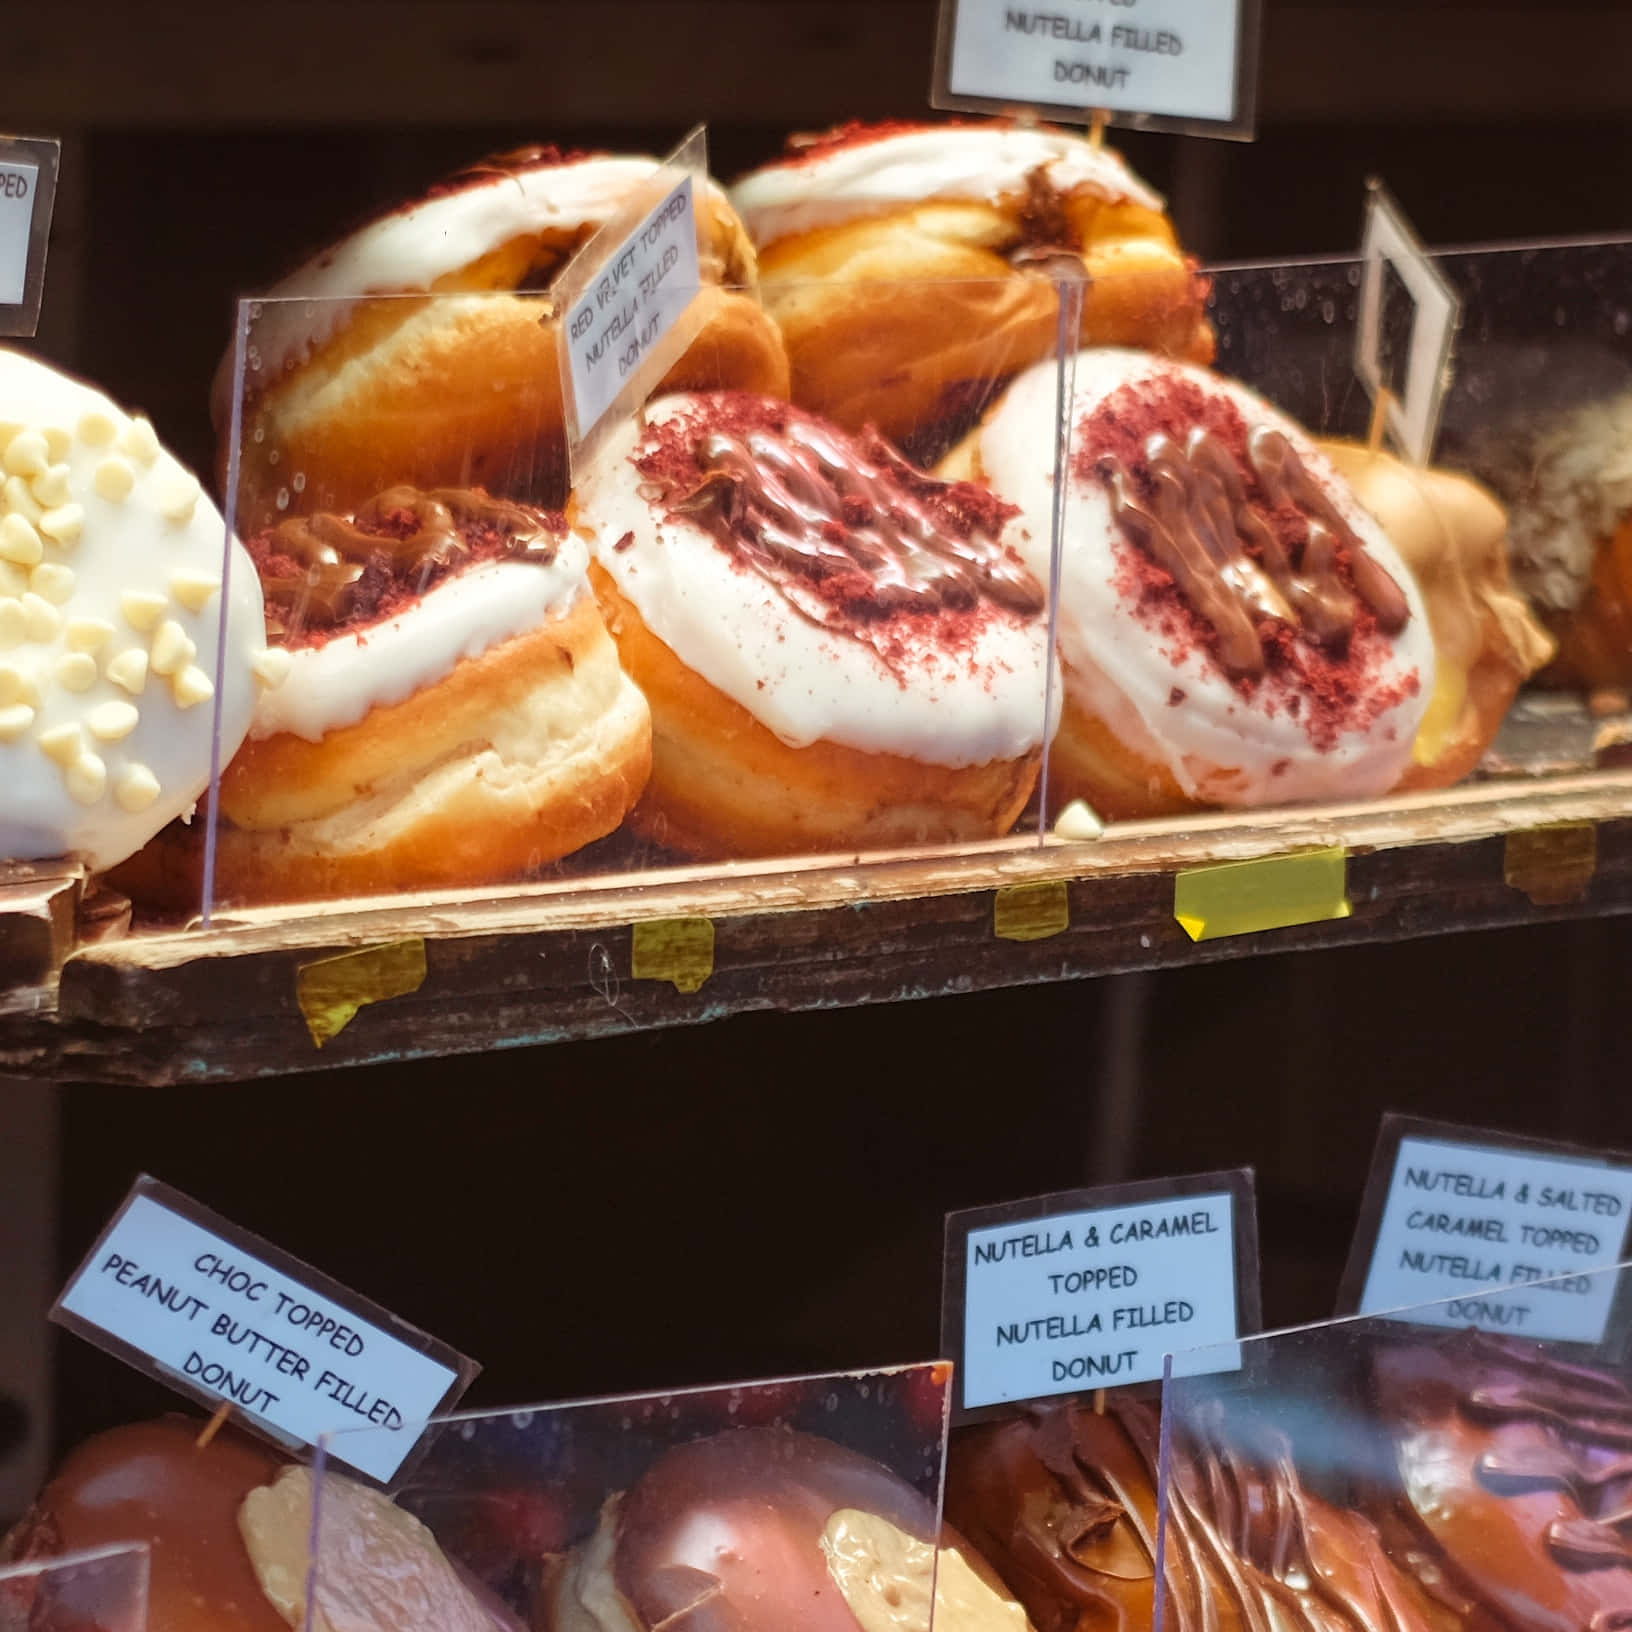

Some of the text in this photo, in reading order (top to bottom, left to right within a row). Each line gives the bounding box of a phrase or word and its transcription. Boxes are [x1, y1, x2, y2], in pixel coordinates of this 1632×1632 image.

[1005, 11, 1182, 56] NUTELLA FILLED
[1053, 60, 1130, 90] DONUT
[570, 308, 594, 344] RED
[641, 194, 687, 251] TOPPED
[585, 302, 639, 373] NUTELLA
[618, 312, 660, 377] DONUT
[1404, 1167, 1623, 1217] NUTELLA & SALTED
[974, 1212, 1218, 1266] NUTELLA & CARAMEL
[1407, 1211, 1600, 1255] CARAMEL TOPPED
[1047, 1265, 1138, 1295] TOPPED
[1400, 1249, 1592, 1296] NUTELLA FILLED
[194, 1253, 365, 1358] CHOC TOPPED
[996, 1301, 1194, 1348] NUTELLA FILLED
[1447, 1300, 1531, 1326] DONUT
[102, 1253, 405, 1432] PEANUT BUTTER FILLED
[1052, 1350, 1139, 1382] DONUT
[182, 1351, 280, 1414] DONUT
